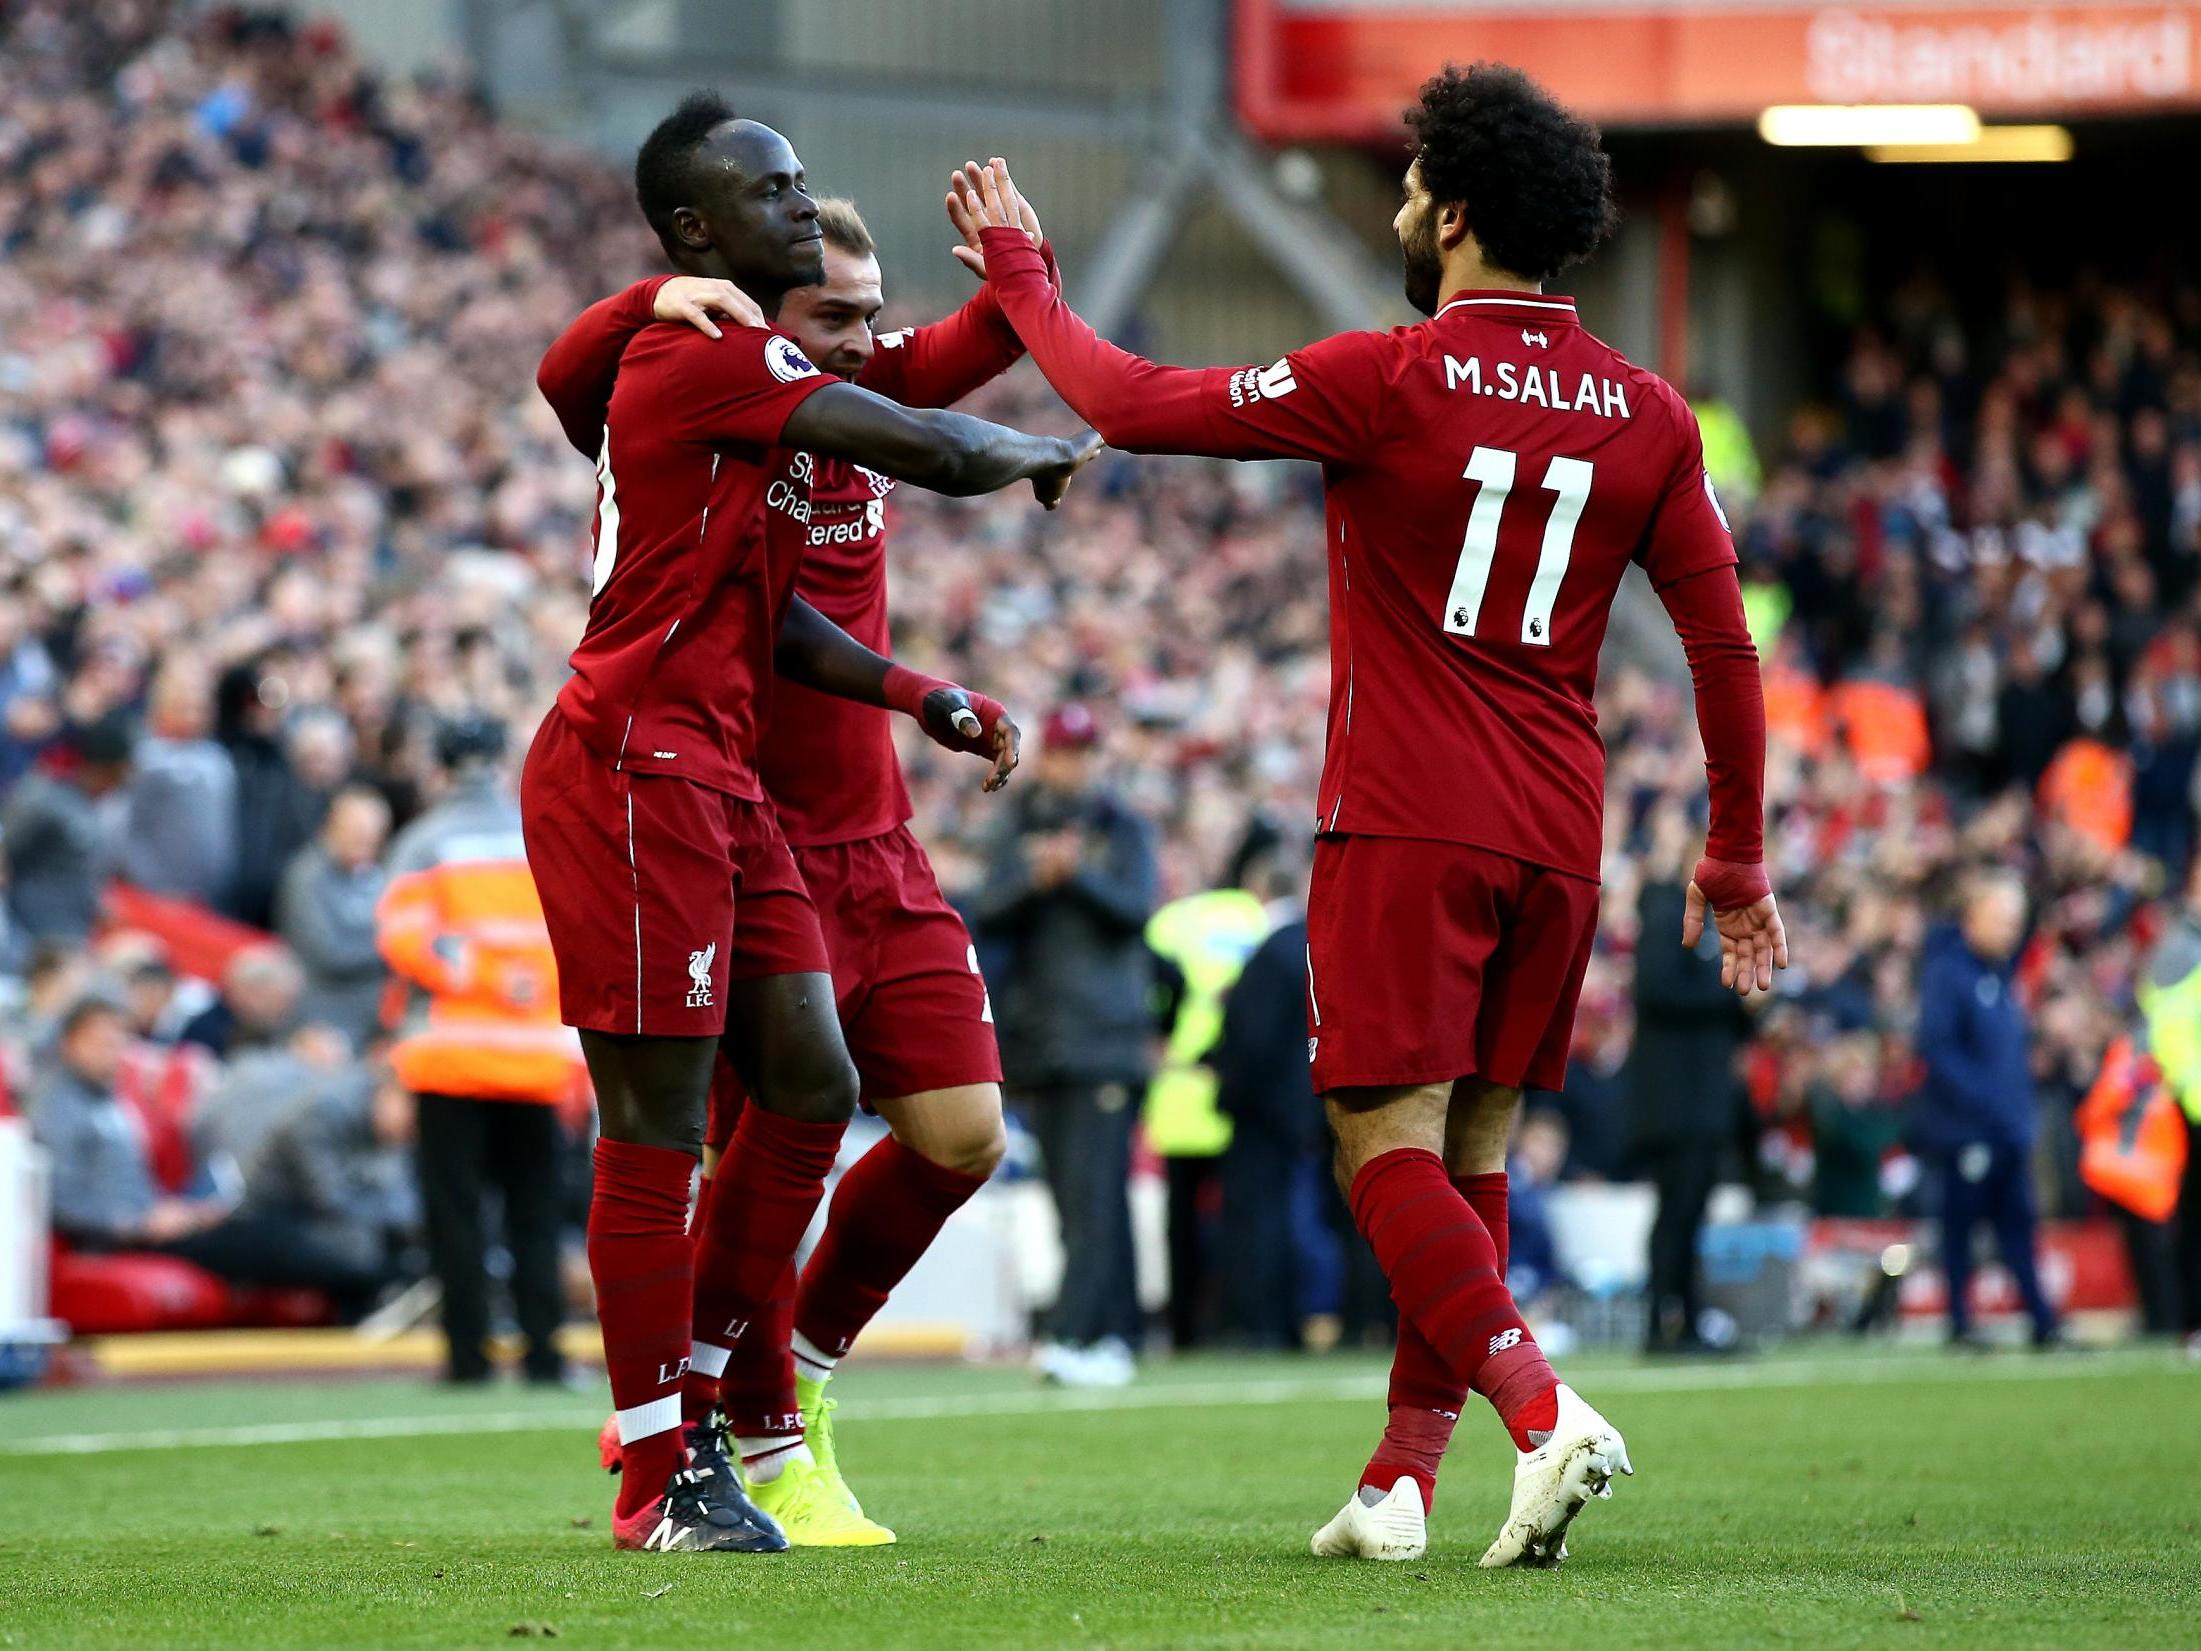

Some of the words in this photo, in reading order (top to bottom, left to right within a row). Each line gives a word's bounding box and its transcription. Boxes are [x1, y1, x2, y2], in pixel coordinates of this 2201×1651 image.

[1806, 8, 2194, 101] Standard
[1443, 354, 1631, 418] M.SALAH
[1443, 445, 1595, 647] 11
